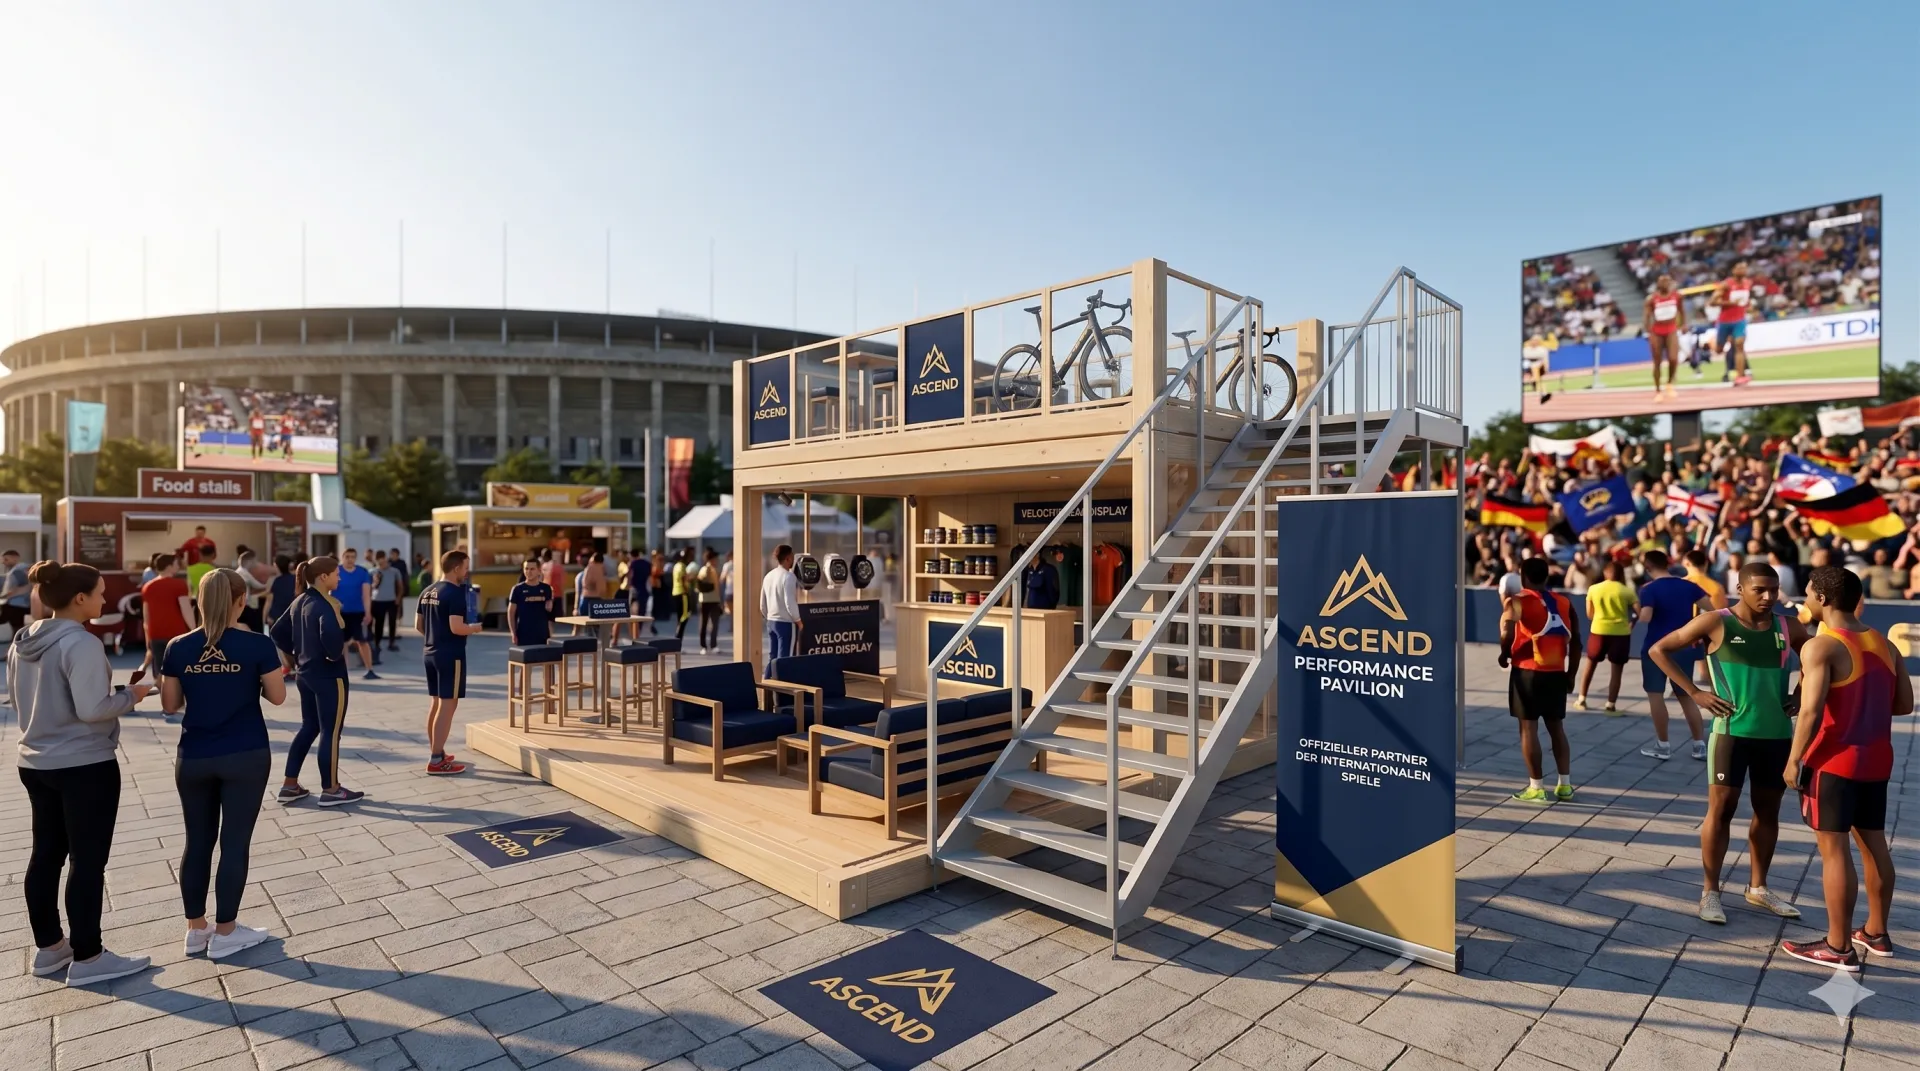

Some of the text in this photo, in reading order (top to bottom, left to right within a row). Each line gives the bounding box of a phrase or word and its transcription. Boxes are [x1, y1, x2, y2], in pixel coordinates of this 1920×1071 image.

[911, 377, 959, 396] ASCEND
[753, 406, 787, 420] ASCEND
[152, 477, 242, 494] Food stalls
[814, 630, 864, 644] VELOCITY
[1296, 625, 1432, 656] ASCEND
[835, 642, 873, 654] DISPLAY
[184, 664, 241, 673] ASCEND
[1294, 656, 1434, 682] PERFORMANCE
[1320, 676, 1404, 699] PAVILION
[1299, 738, 1428, 767] OFFIZIELLER PARTNER
[1296, 751, 1431, 782] DER INTERNATIONALEN
[1341, 772, 1381, 788] SPIELE
[475, 831, 530, 858] ASCEND
[809, 976, 936, 1044] ASCEND
